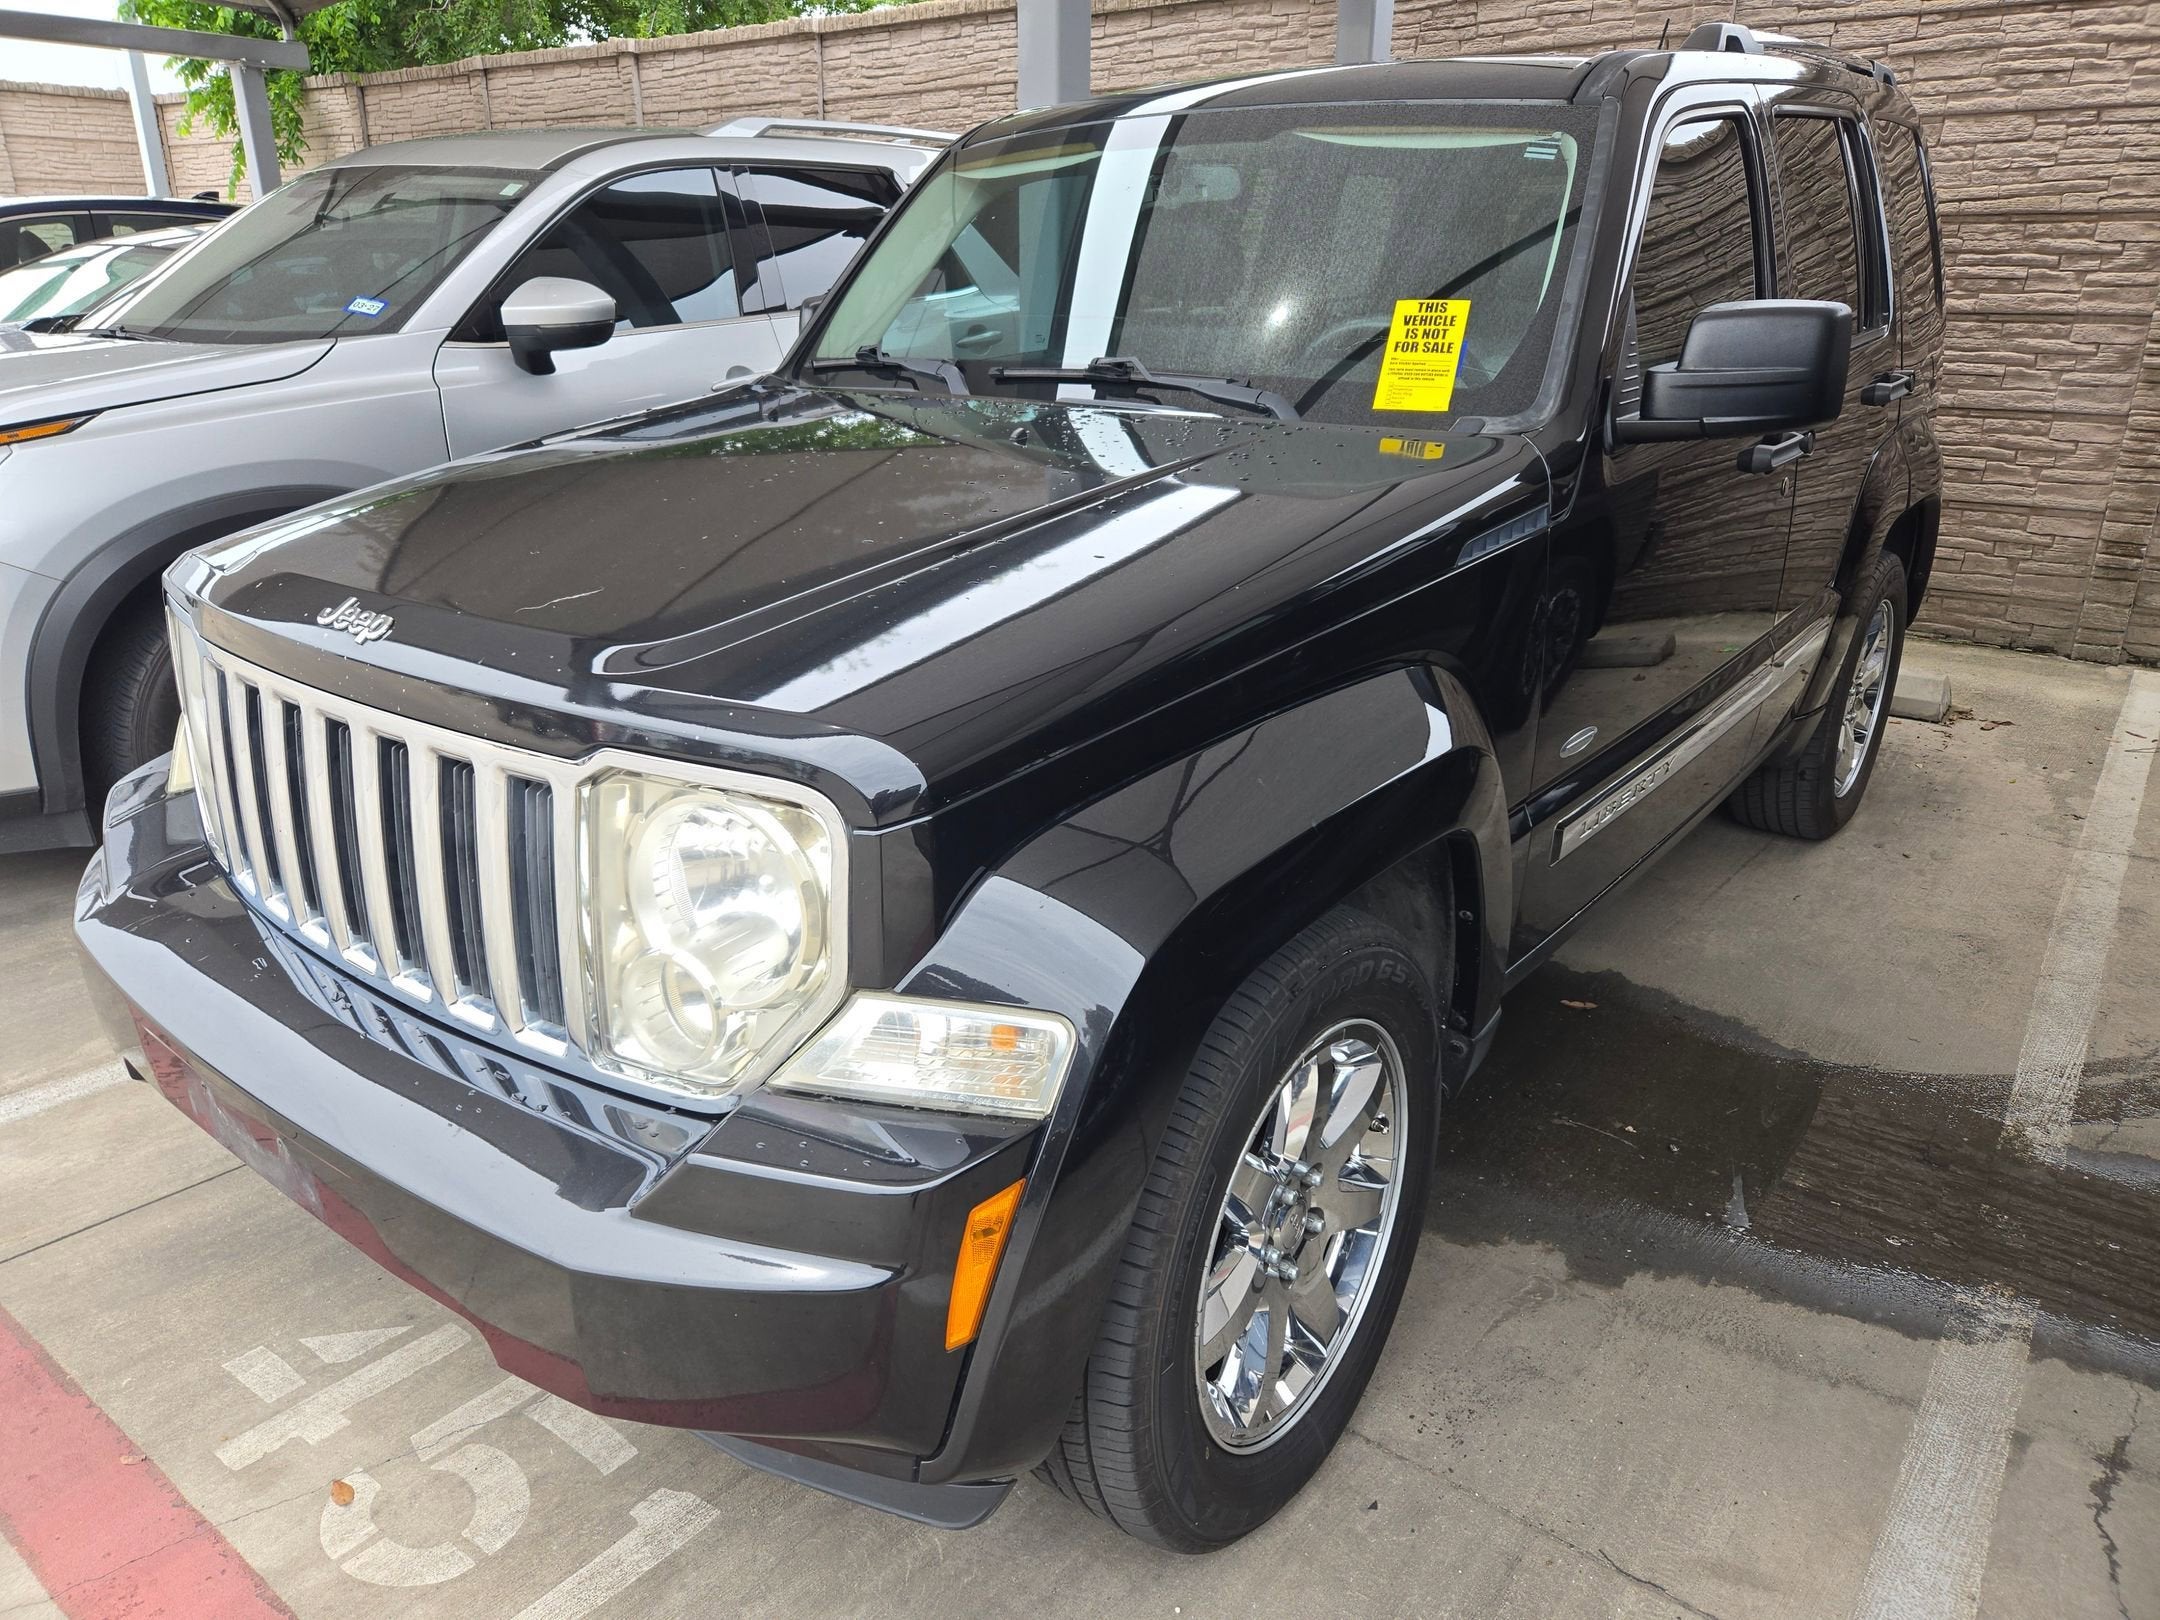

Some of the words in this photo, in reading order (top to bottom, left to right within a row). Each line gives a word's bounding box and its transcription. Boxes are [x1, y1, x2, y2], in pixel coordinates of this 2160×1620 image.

[1417, 302, 1449, 314] THIS
[1403, 315, 1457, 327] VEHICLE
[1405, 328, 1419, 340] IS
[1421, 328, 1450, 340] NOT
[1393, 341, 1419, 353] FOR
[1422, 342, 1455, 354] SALE
[316, 596, 394, 646] Jeep
[1579, 752, 1679, 839] LIBERTY
